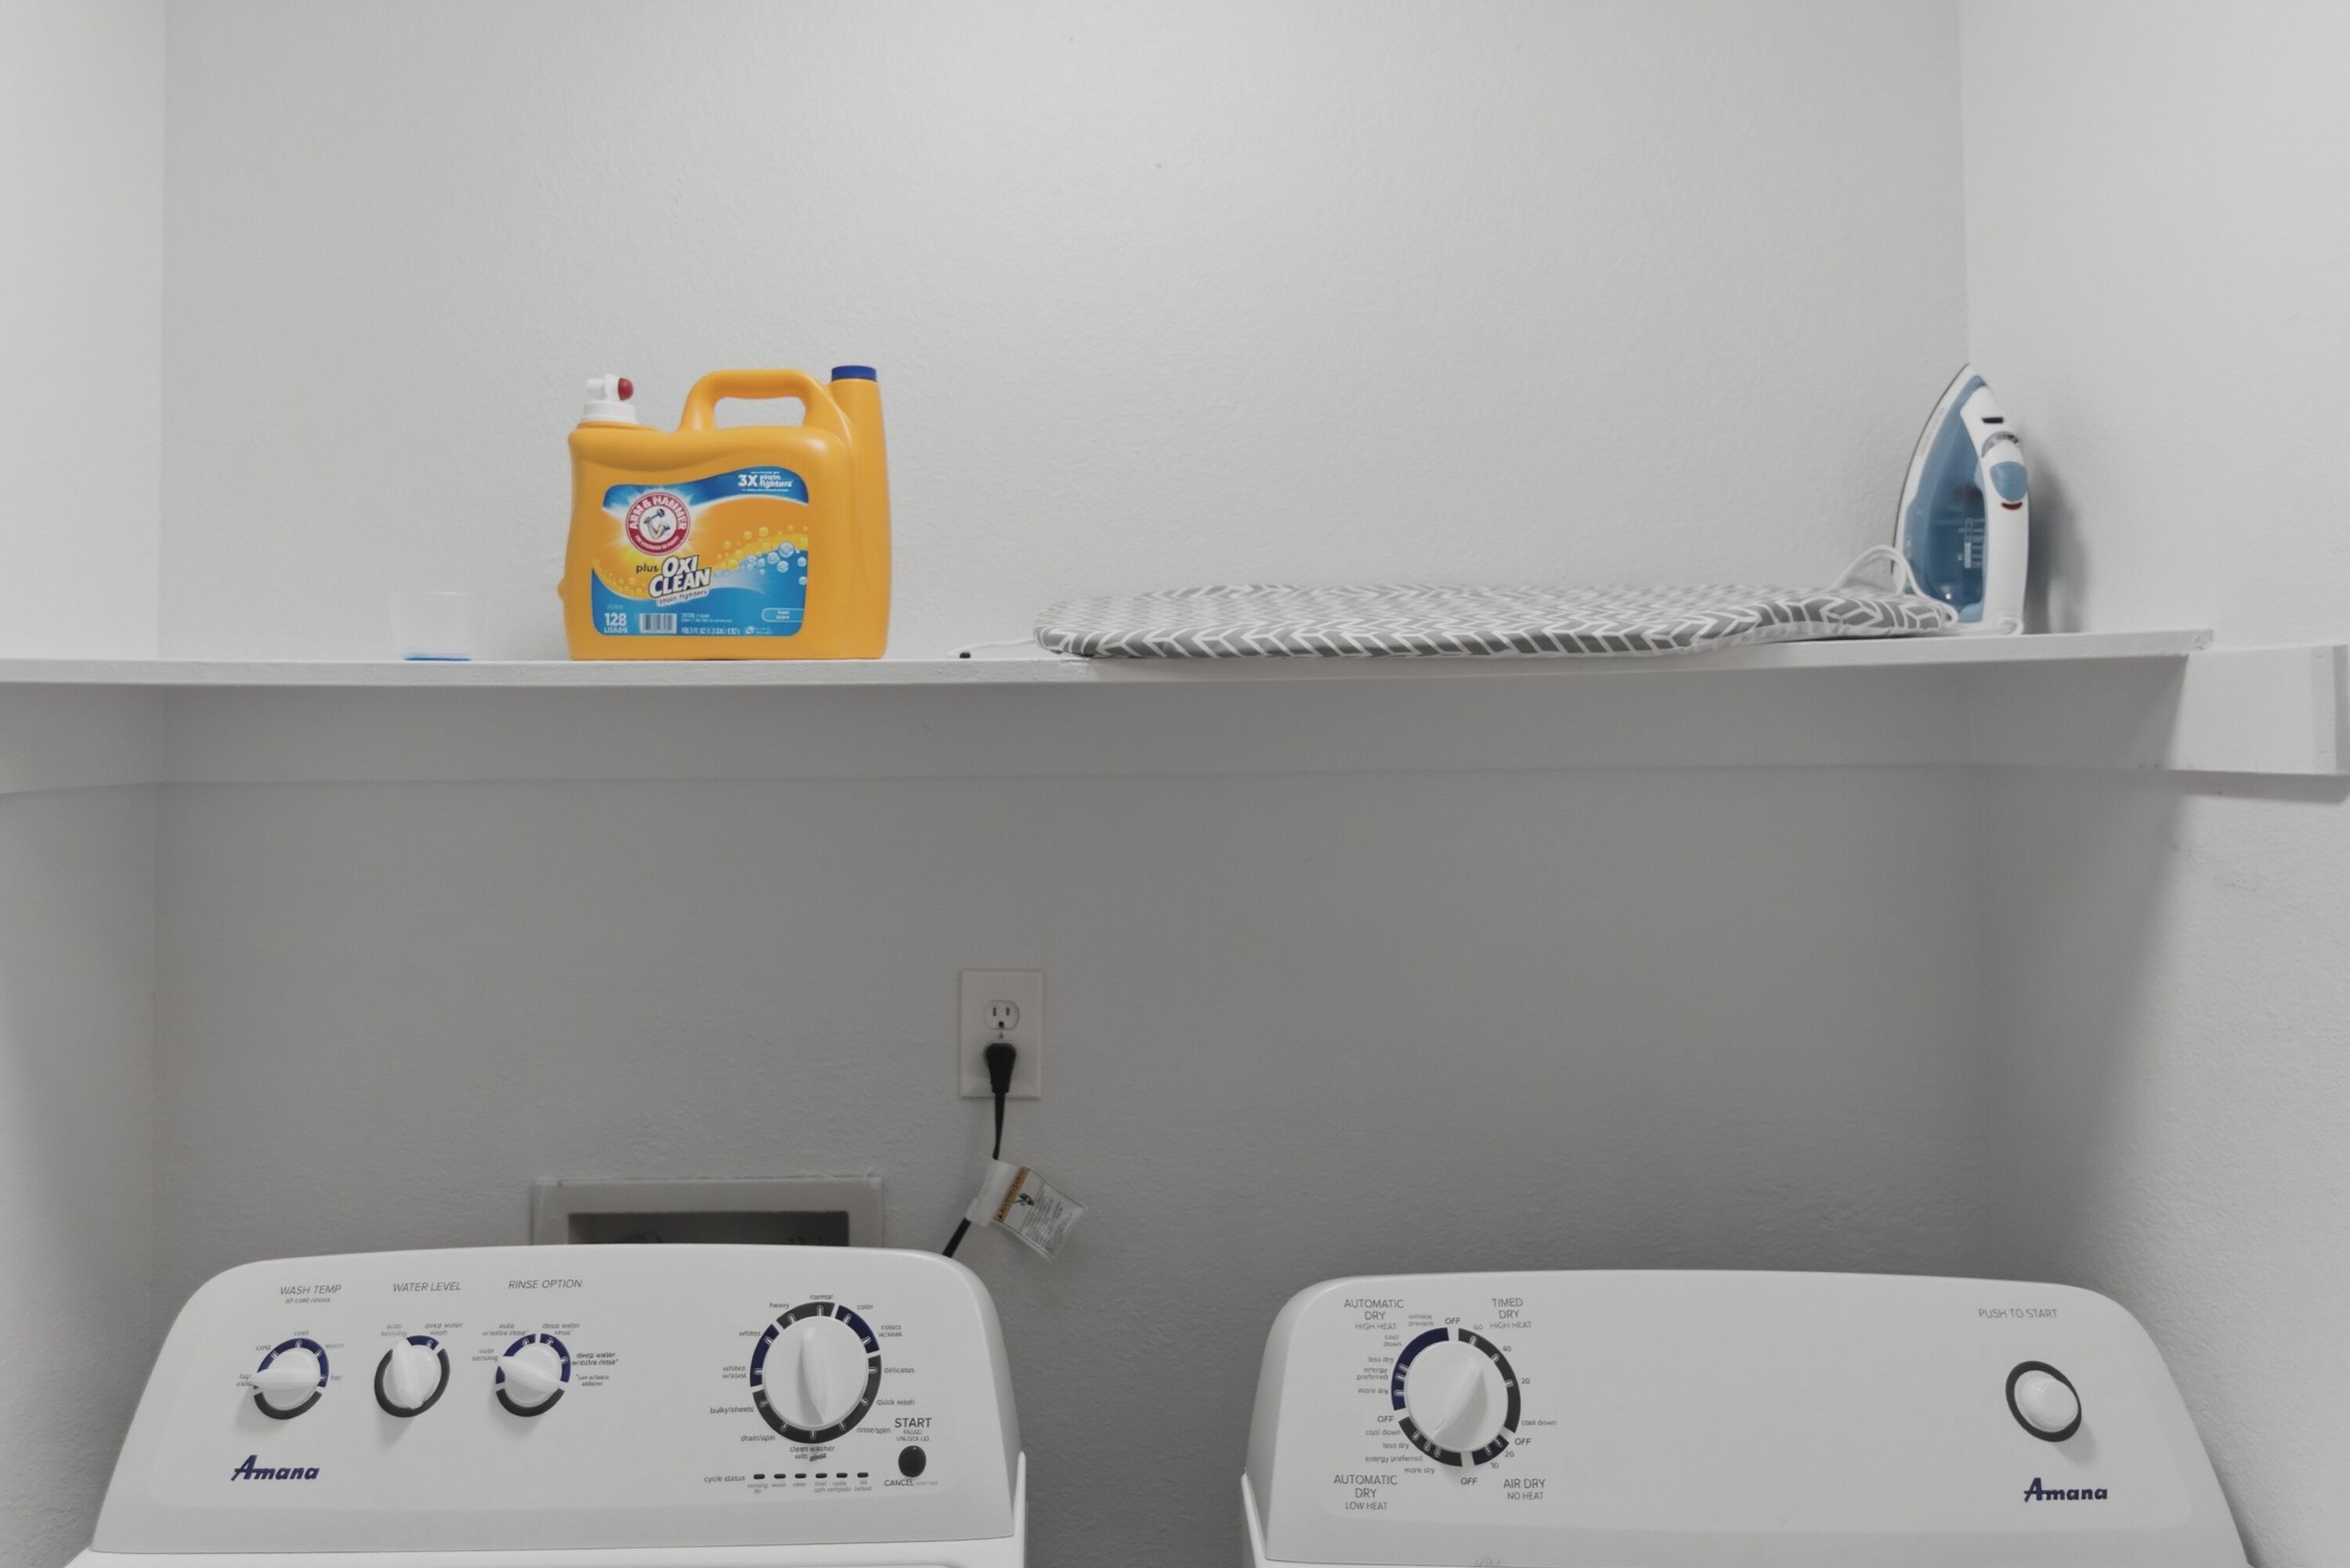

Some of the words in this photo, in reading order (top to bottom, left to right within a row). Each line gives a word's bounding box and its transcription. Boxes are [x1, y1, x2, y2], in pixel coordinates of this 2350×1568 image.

[738, 474, 758, 487] 3X
[628, 504, 644, 530] ARM
[642, 498, 653, 508] &
[652, 496, 688, 530] HAMMER
[635, 563, 660, 574] plus
[661, 555, 700, 578] OXI
[649, 566, 712, 598] CLEAN
[604, 612, 627, 627] 128
[392, 1282, 428, 1292] WATER
[430, 1281, 461, 1292] LEVEL
[508, 1280, 539, 1289] RINSE
[541, 1278, 583, 1288] OPTION
[280, 1285, 310, 1295] WASH
[314, 1284, 342, 1294] TEMP
[1343, 1299, 1405, 1309] AUTOMATIC
[1491, 1298, 1524, 1308] TIMED
[1364, 1310, 1386, 1321] DRY
[1499, 1310, 1520, 1320] DRY
[1978, 1308, 2007, 1318] PUSH
[2010, 1308, 2024, 1318] TO
[2026, 1308, 2058, 1319] START
[1444, 1317, 1461, 1325] OFF
[895, 1418, 933, 1429] START
[1514, 1437, 1532, 1446] OFF
[230, 1454, 320, 1481] Amana
[703, 1475, 722, 1483] cycle
[884, 1478, 914, 1487] CANCEL
[1333, 1474, 1398, 1485] AUTOMATIC
[1460, 1477, 1478, 1486] OFF
[1503, 1478, 1521, 1489] AIR
[1524, 1478, 1546, 1489] DRY
[1354, 1487, 1377, 1498] DRY
[1522, 1491, 1544, 1500] HEAT
[2023, 1477, 2108, 1503] Amana
[1345, 1501, 1365, 1510] LOW
[1366, 1501, 1388, 1510] HEAT
